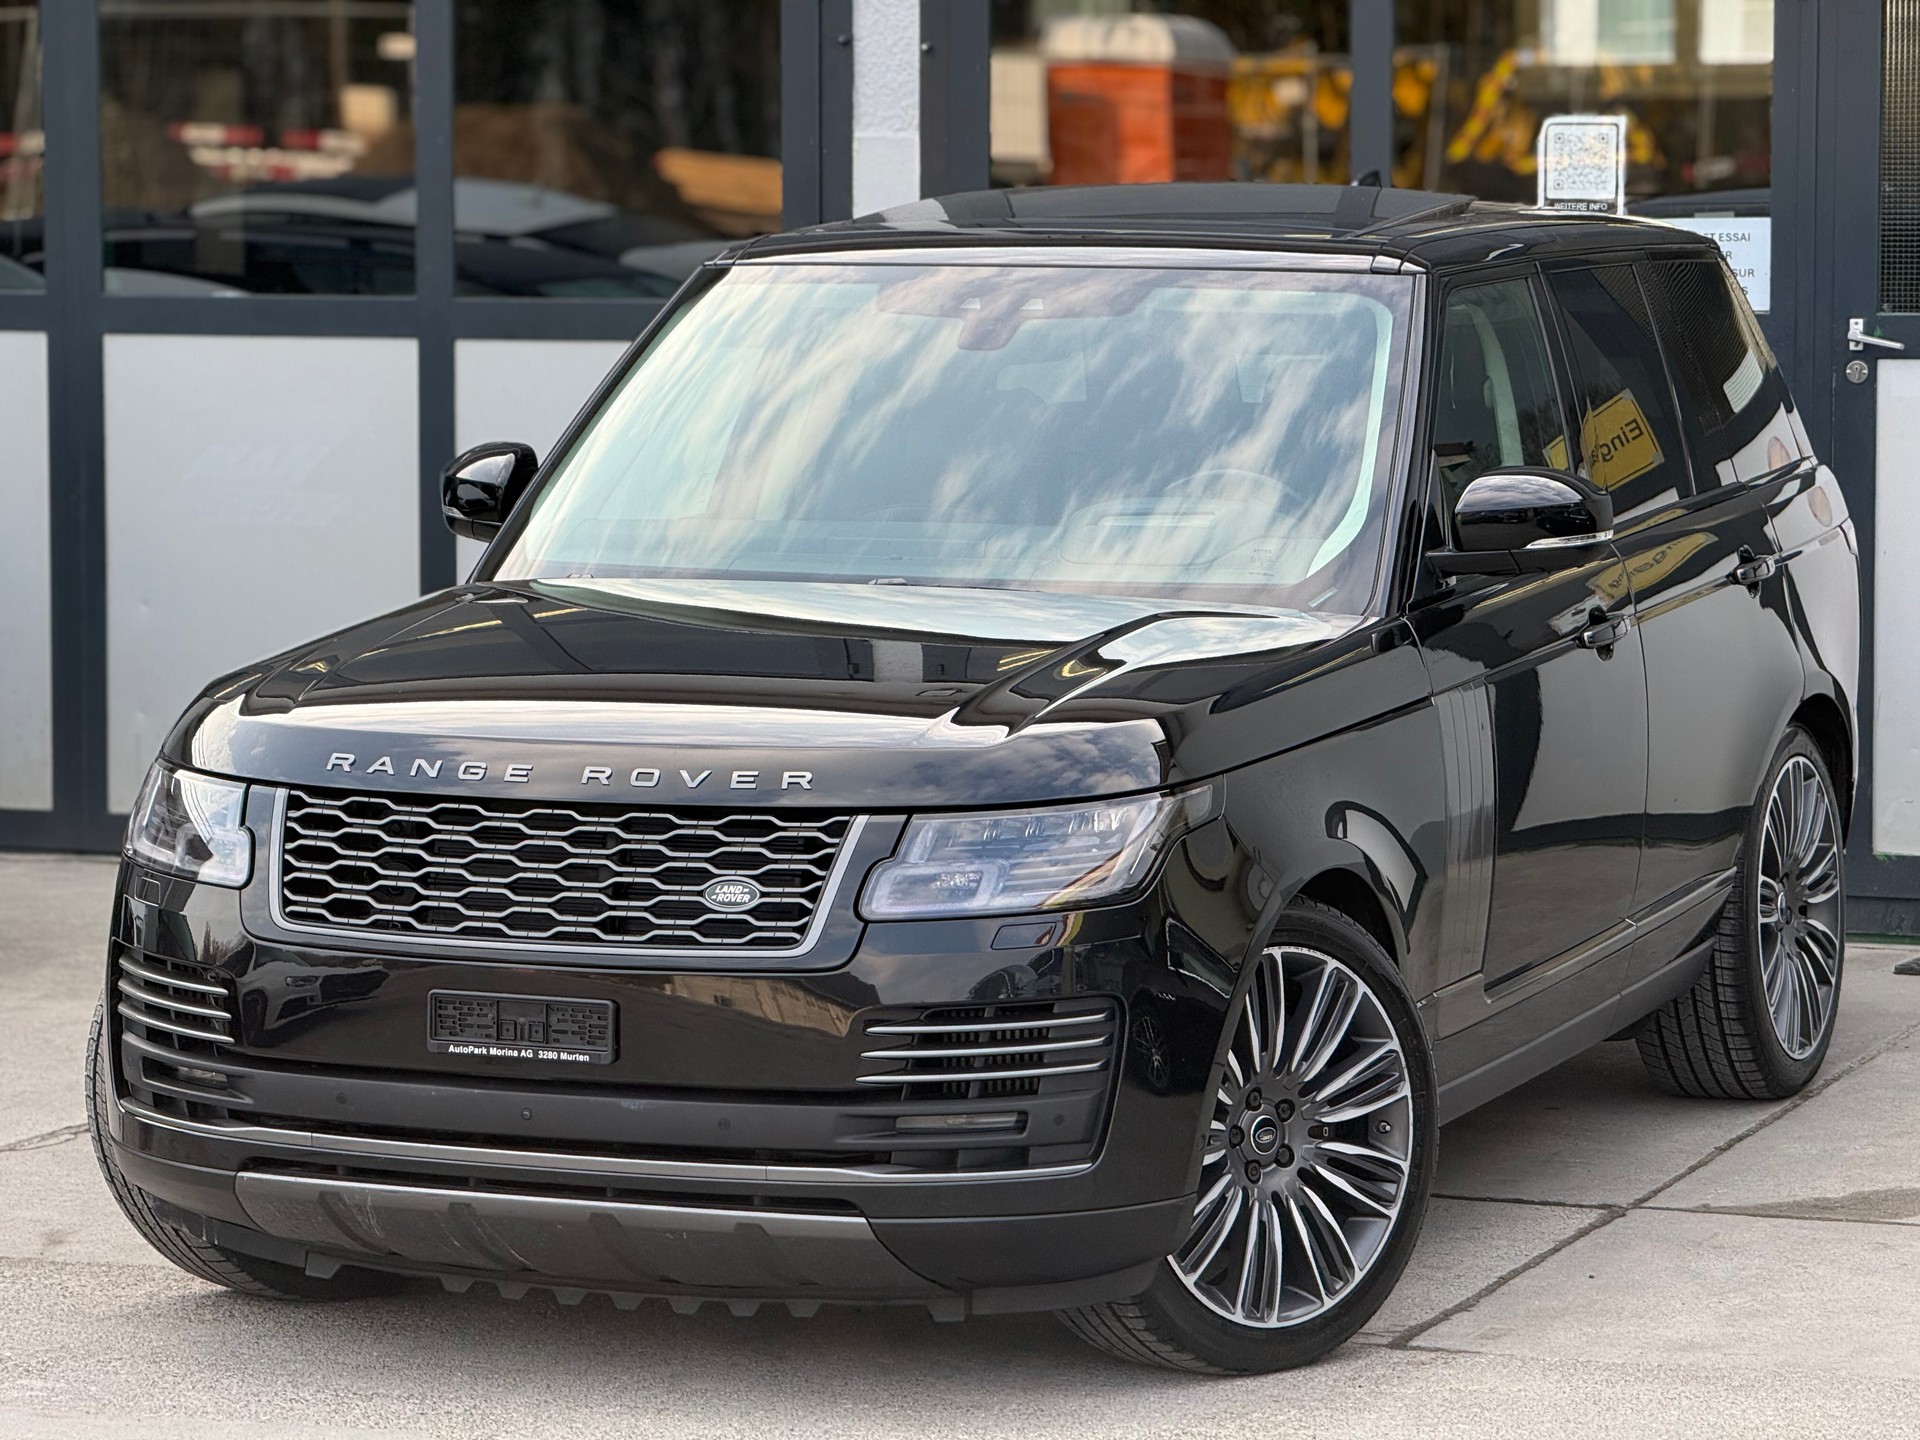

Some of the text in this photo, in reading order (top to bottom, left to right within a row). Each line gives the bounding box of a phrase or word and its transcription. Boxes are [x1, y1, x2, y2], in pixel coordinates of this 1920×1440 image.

[1589, 202, 1608, 211] INFO
[1718, 232, 1751, 242] ESSAI
[326, 752, 813, 791] RANGE ROVER
[715, 885, 743, 893] LAND
[716, 894, 751, 902] ROVER
[448, 1044, 590, 1063] AutoPark Morina AG 3280 Murten
